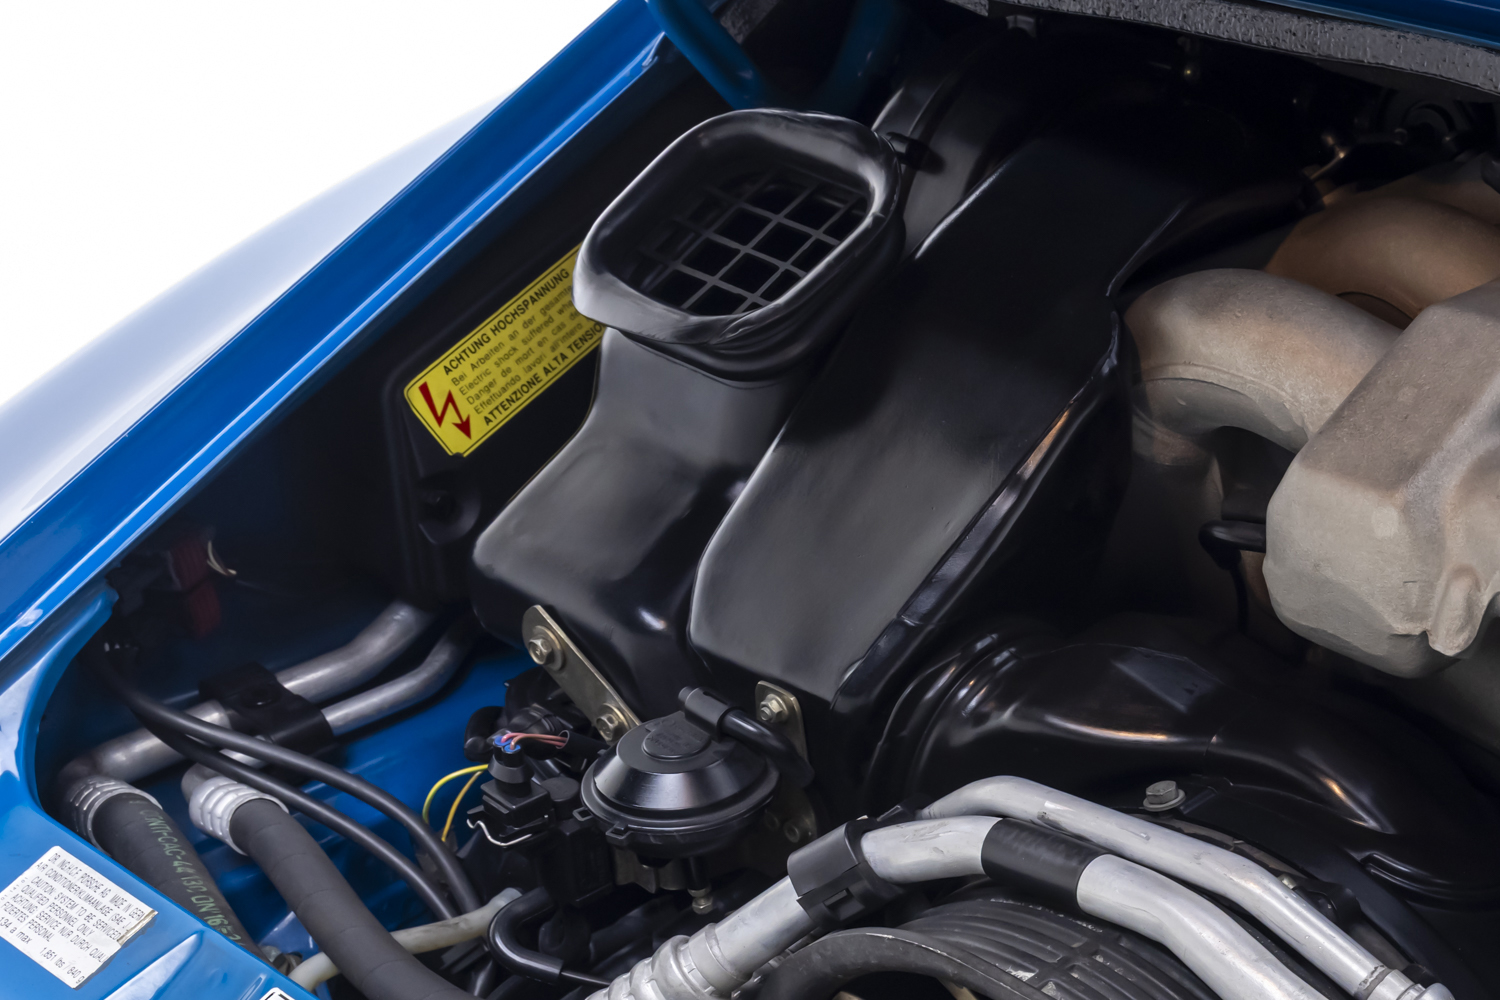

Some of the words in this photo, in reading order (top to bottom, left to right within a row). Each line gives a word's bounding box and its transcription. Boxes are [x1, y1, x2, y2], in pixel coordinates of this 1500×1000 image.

[441, 331, 492, 376] ACHTUNG
[488, 267, 571, 336] HOCHSPANNUNG
[450, 370, 468, 387] Bei
[469, 340, 506, 372] Arbeiten
[506, 328, 520, 342] an
[521, 314, 536, 330] der
[458, 366, 492, 396] Electric
[492, 344, 519, 368] shock
[520, 313, 555, 346] suffered
[465, 377, 498, 406] Danger
[499, 365, 513, 378] de
[514, 346, 535, 366] mort
[536, 335, 549, 348] en
[550, 320, 567, 336] cas
[482, 371, 543, 426] ATTENZIONE
[541, 350, 569, 377] ALTA
[19, 884, 50, 907] QUALIFIED
[45, 901, 79, 928] PERSONNEL
[75, 922, 95, 937] ONLY
